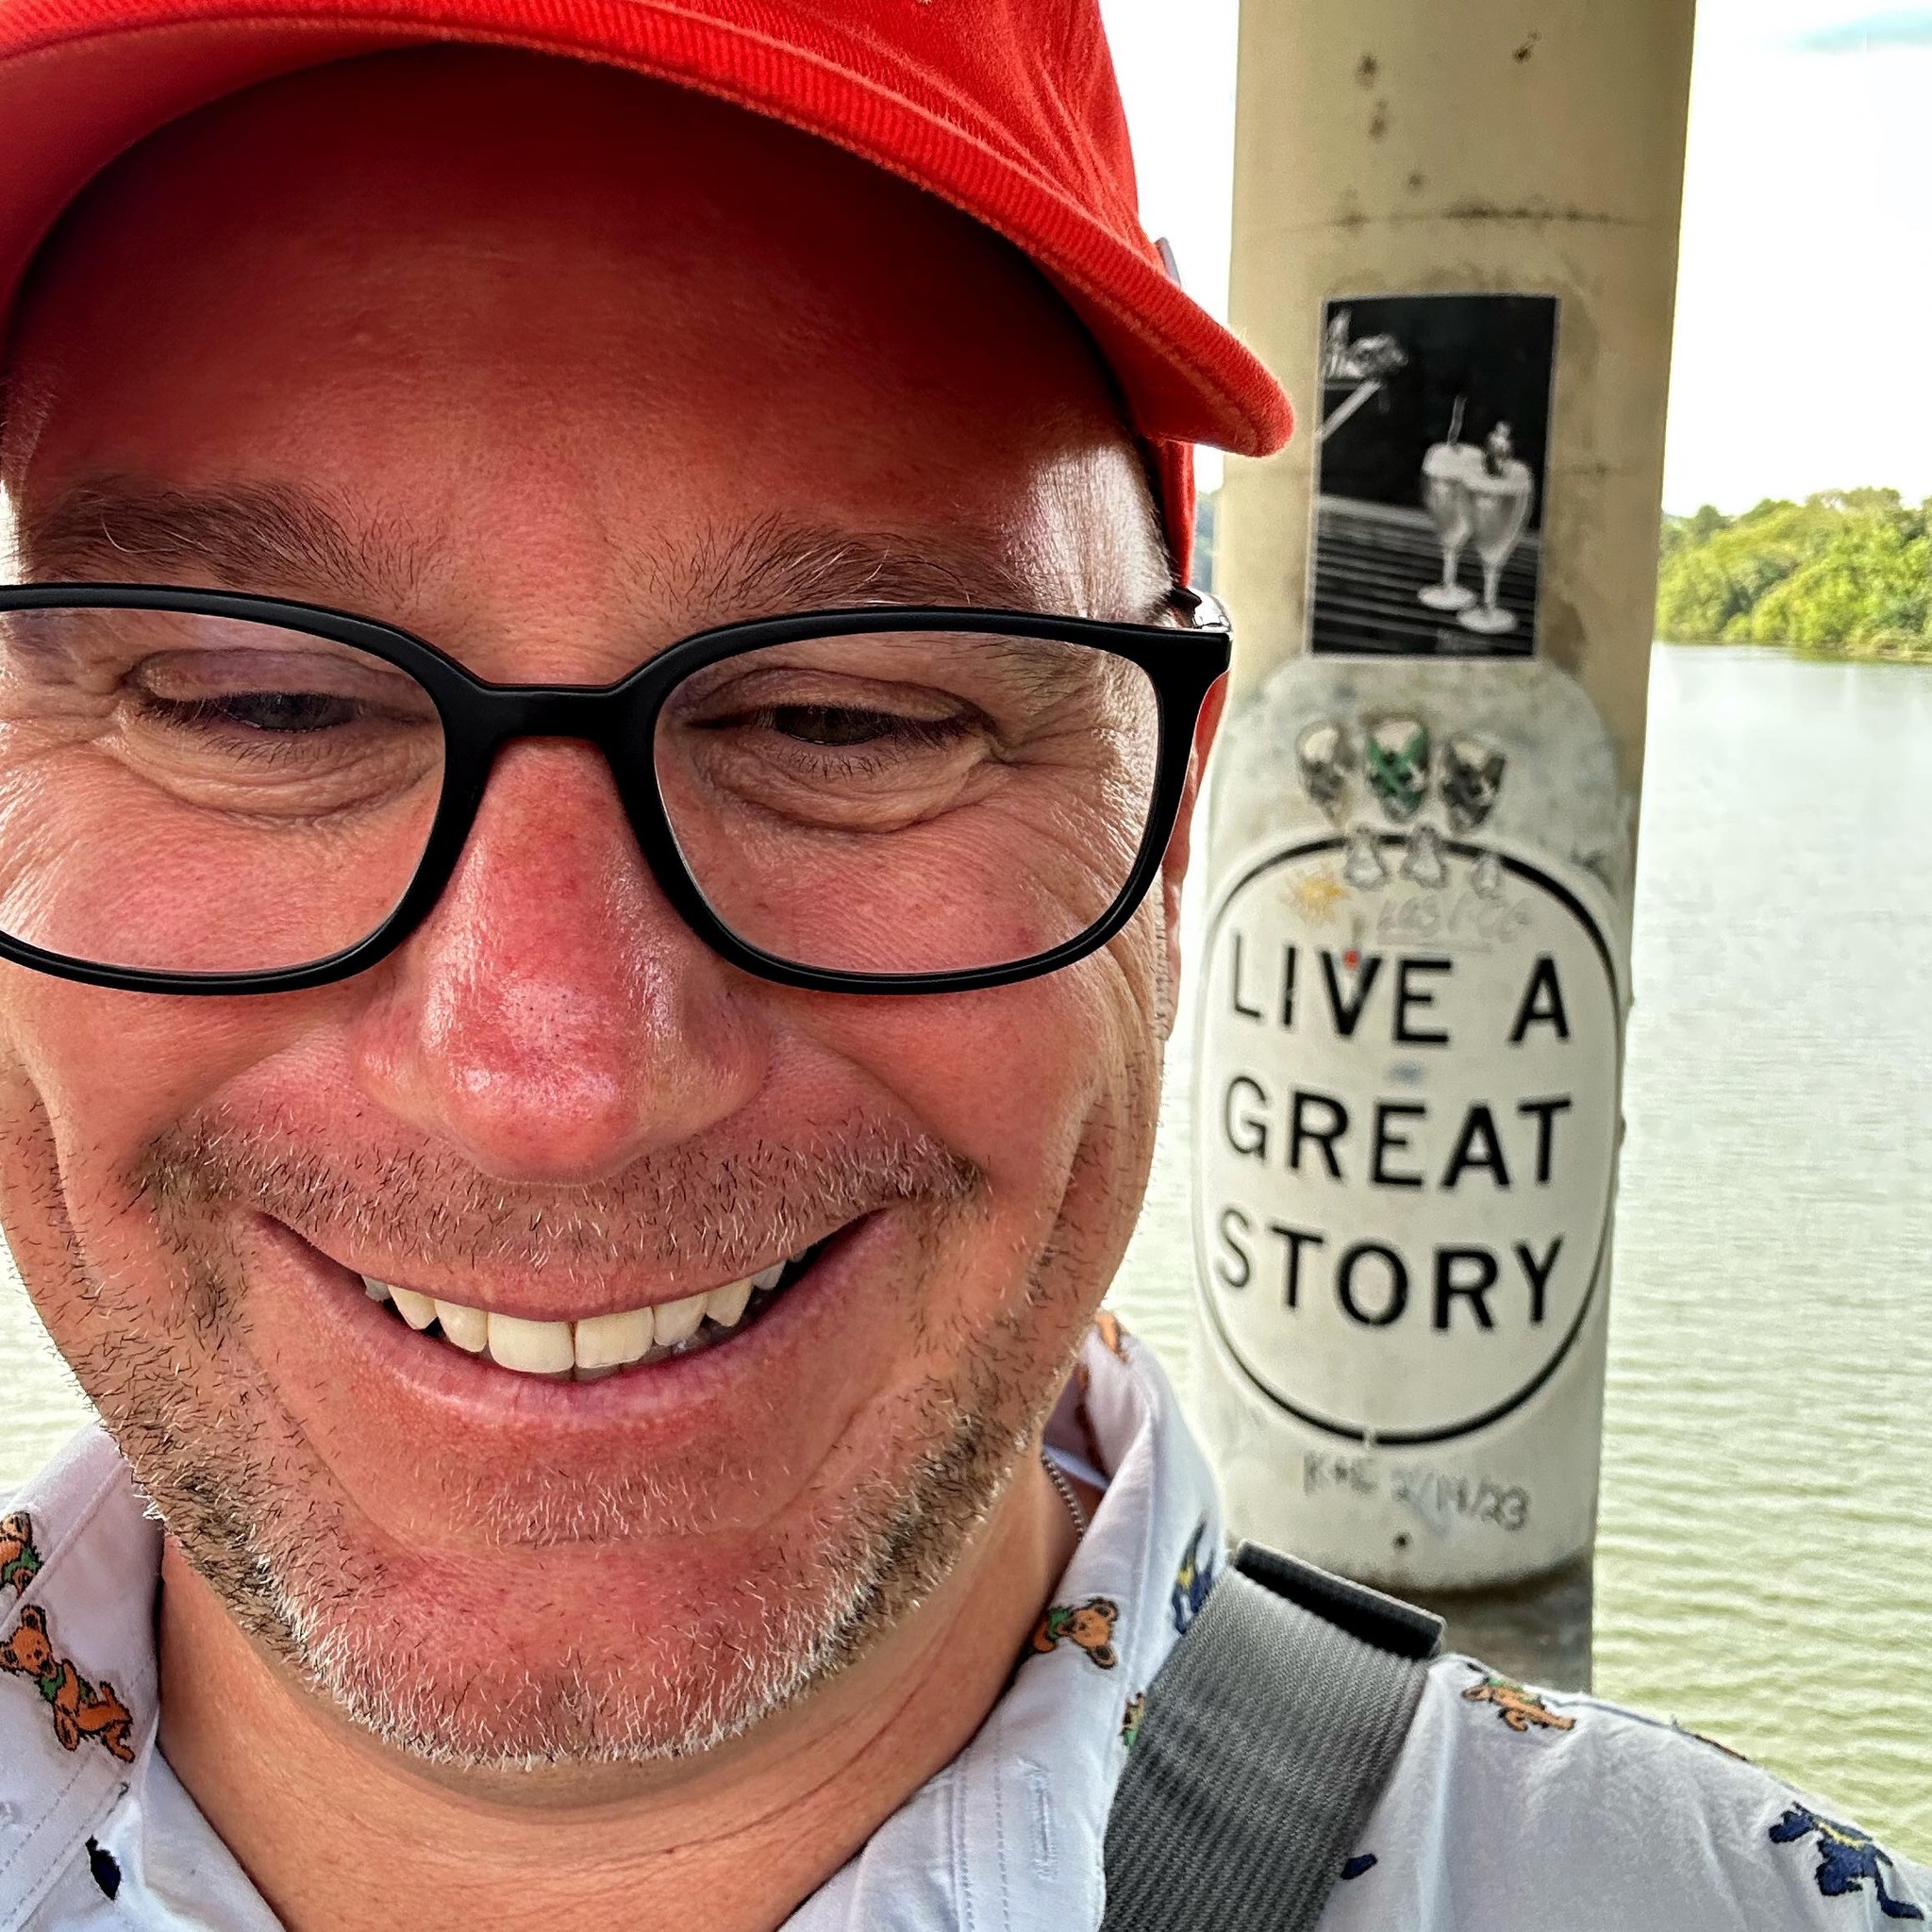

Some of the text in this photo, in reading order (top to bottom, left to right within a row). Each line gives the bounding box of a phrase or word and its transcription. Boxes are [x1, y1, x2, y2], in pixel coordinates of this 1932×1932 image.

[1233, 933, 1571, 1046] LIVE A
[1224, 1074, 1573, 1189] GREAT
[1215, 1208, 1563, 1331] STORY
